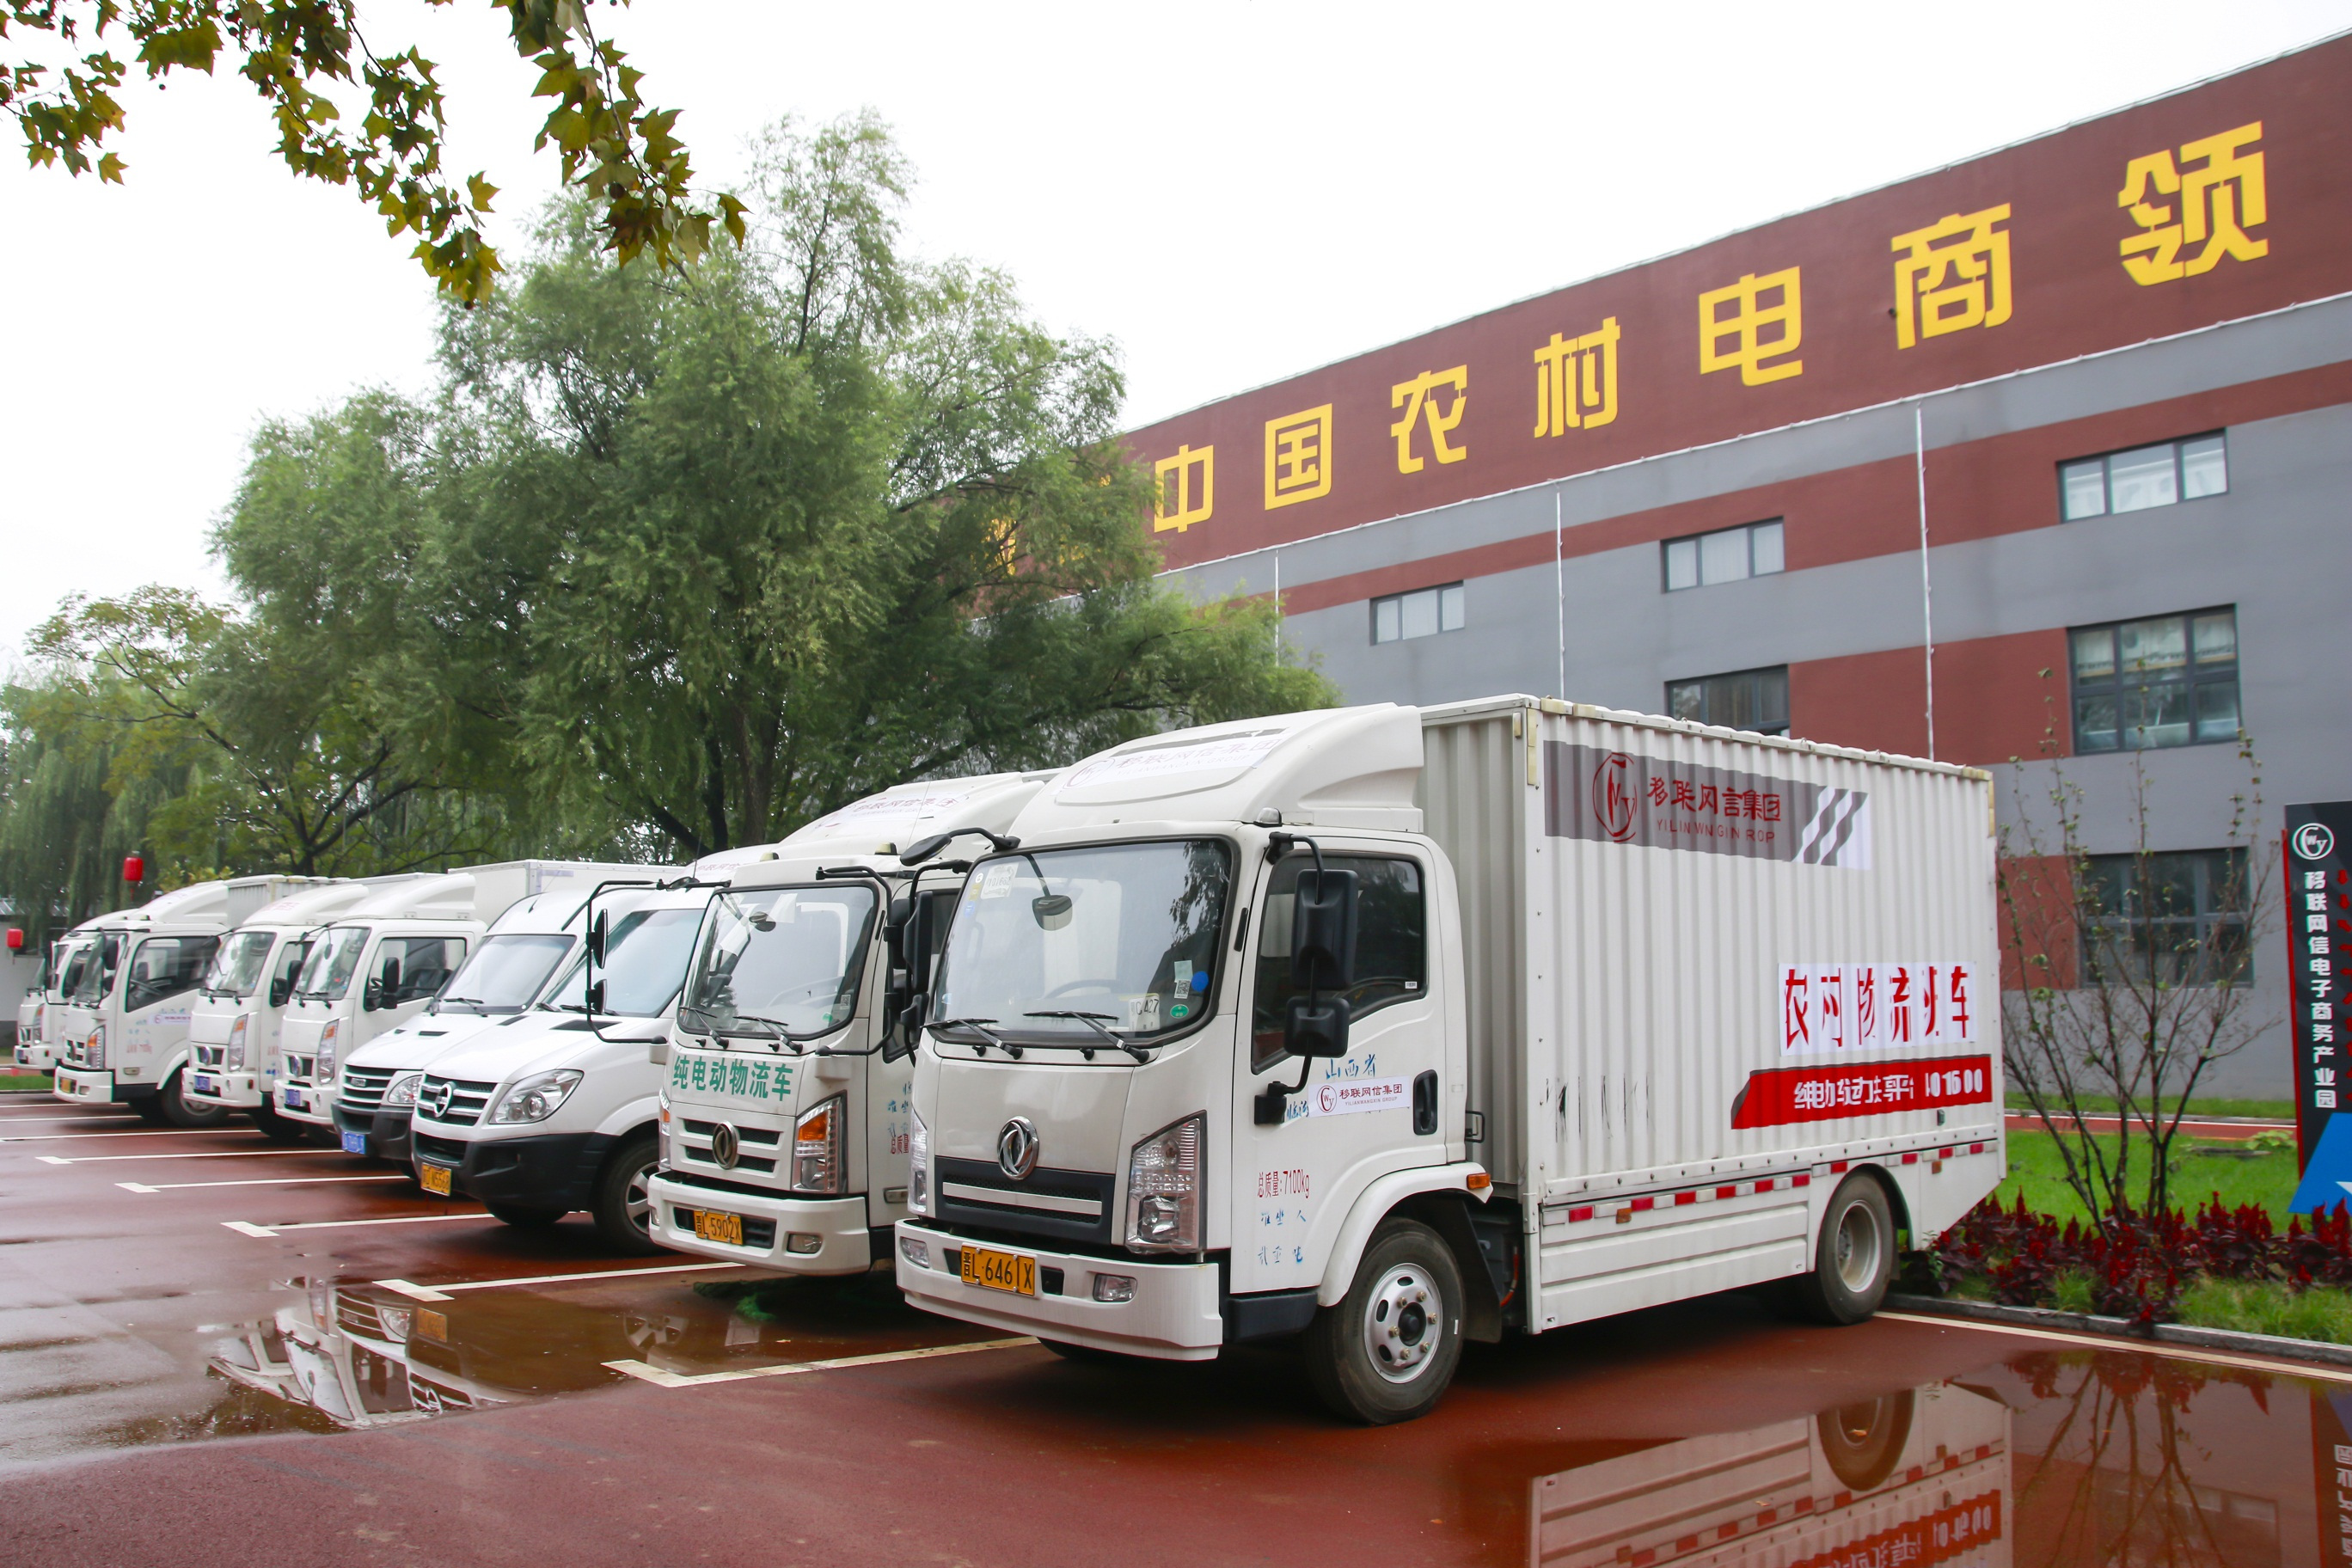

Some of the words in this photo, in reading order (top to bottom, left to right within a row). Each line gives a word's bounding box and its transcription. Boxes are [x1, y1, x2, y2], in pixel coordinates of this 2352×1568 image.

[1154, 120, 2269, 534] 中国农村电商领
[2304, 870, 2337, 1109] 移联网信电子商务产业园
[672, 1055, 793, 1102] 纯电动物流车
[1339, 1083, 1402, 1099] 移联网信集团
